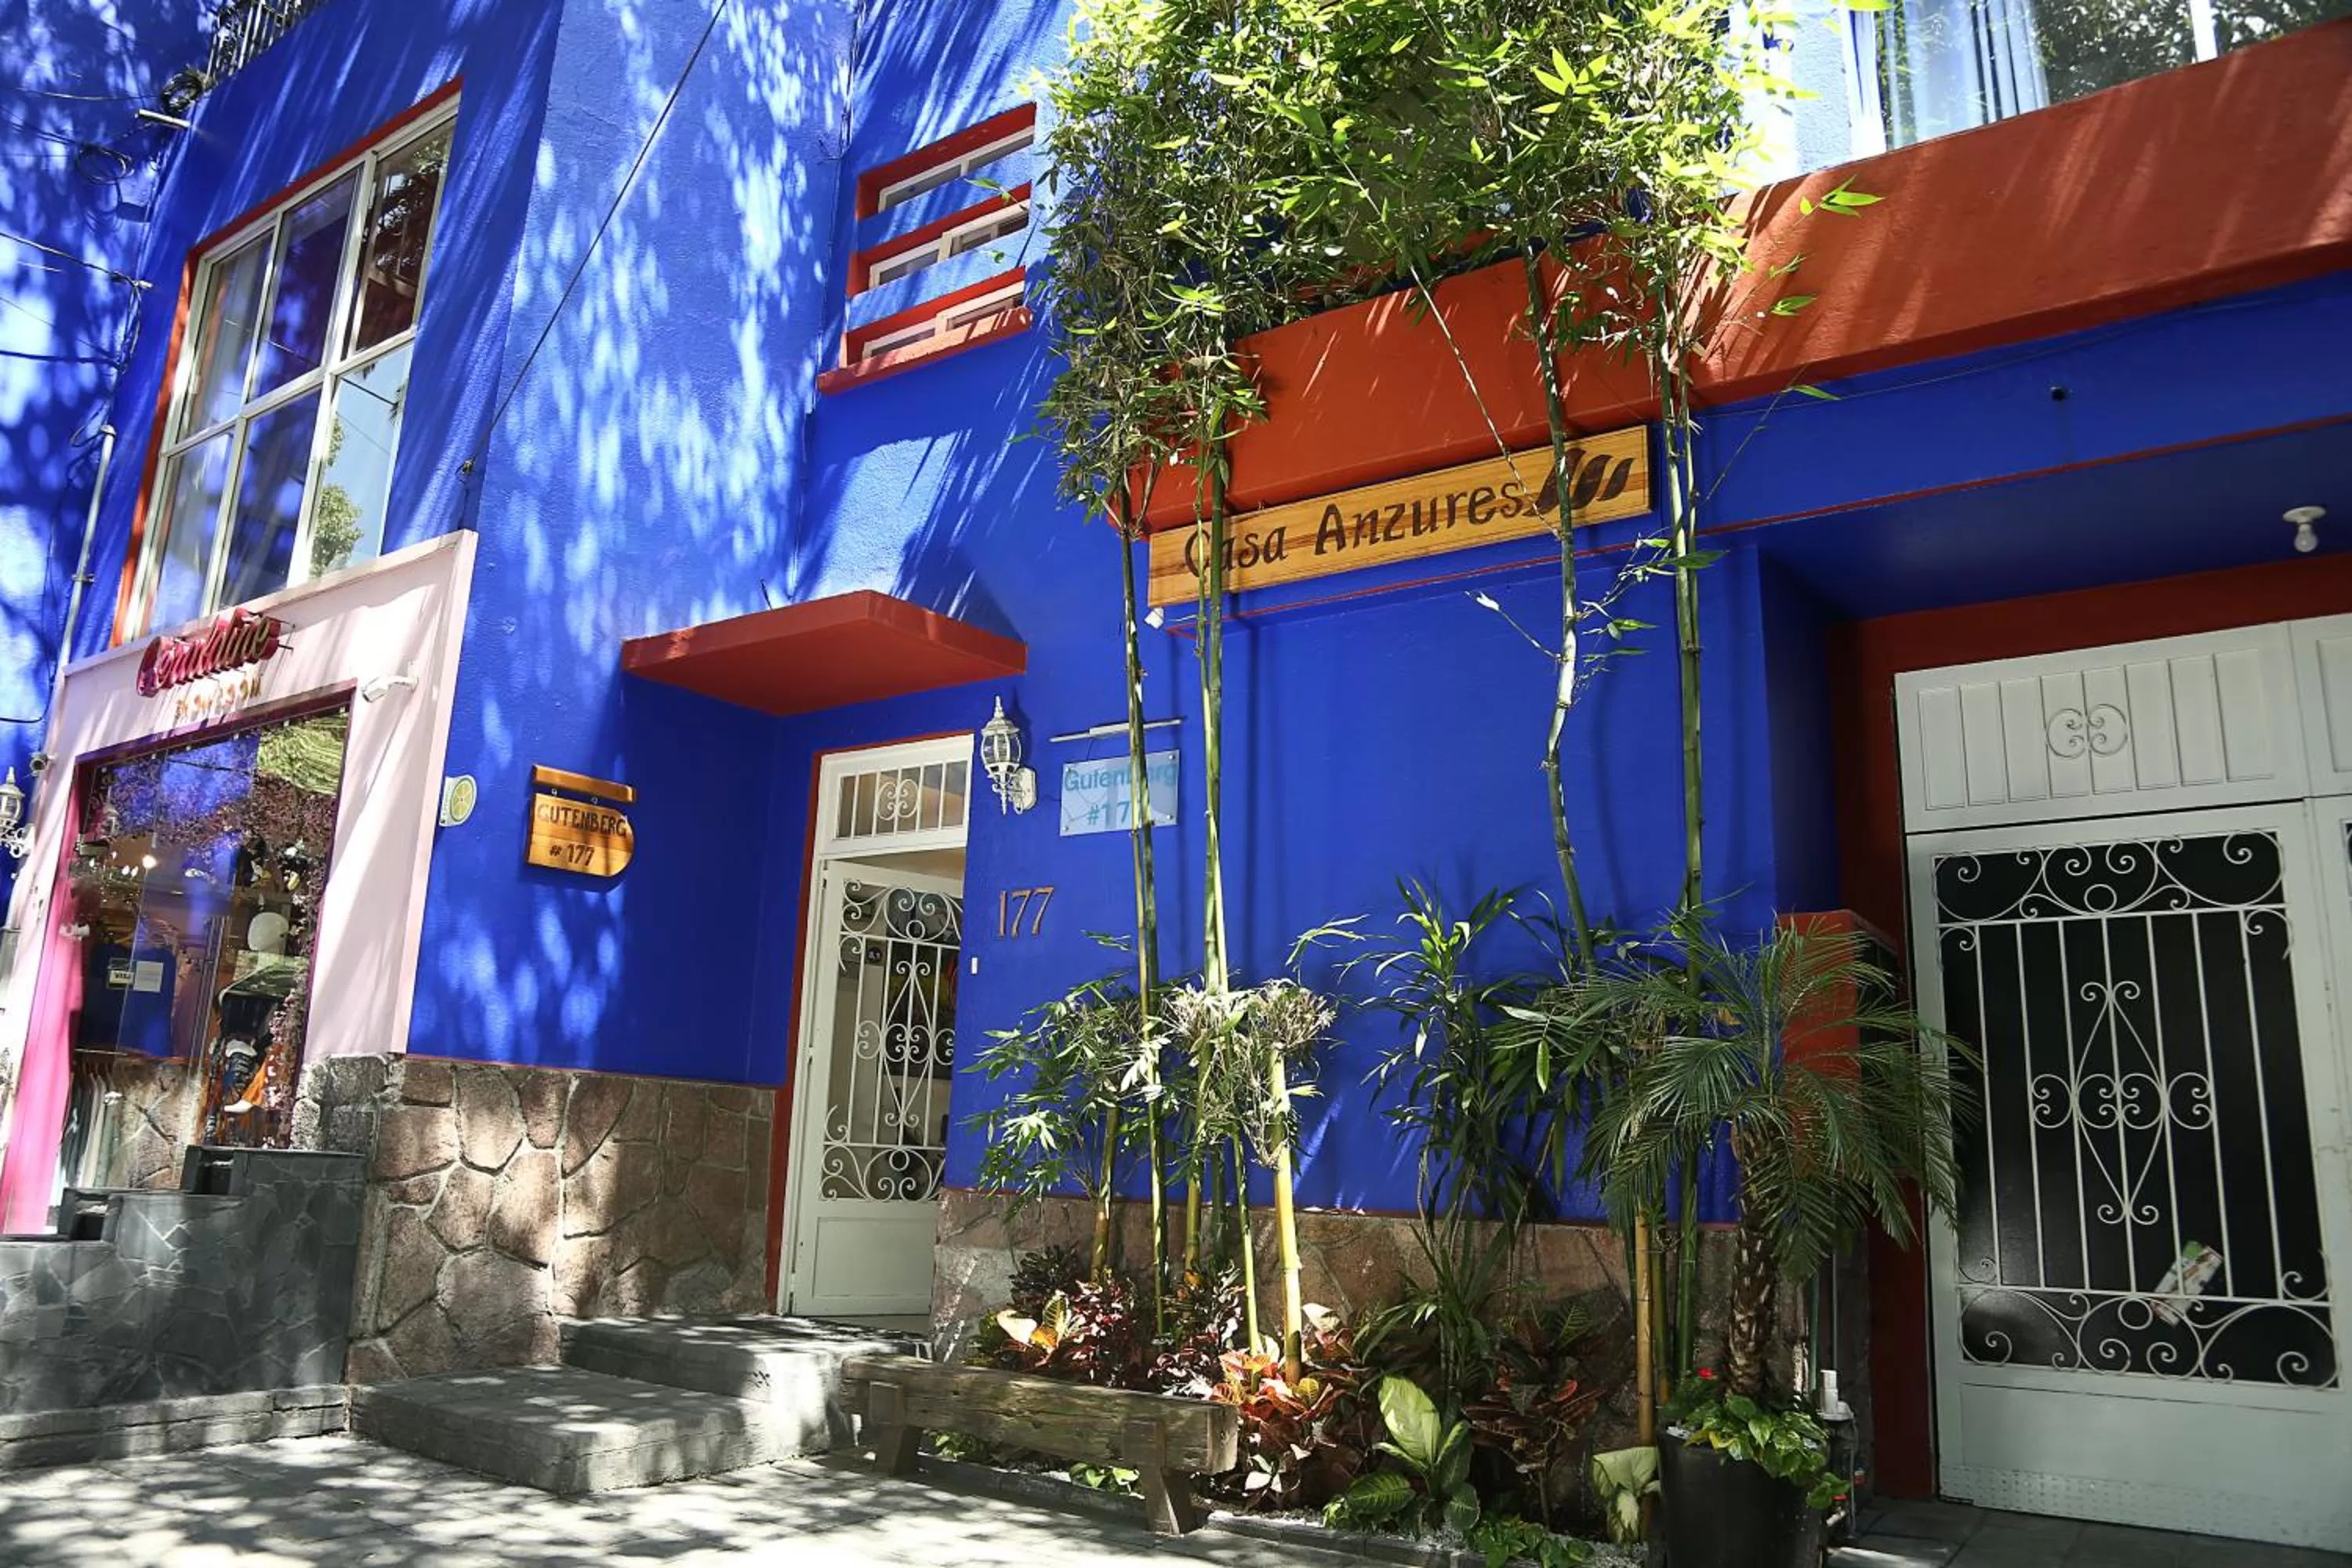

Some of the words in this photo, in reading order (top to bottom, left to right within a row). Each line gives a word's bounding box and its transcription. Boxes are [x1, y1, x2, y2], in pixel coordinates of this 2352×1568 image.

[1185, 527, 1288, 578] Casa
[1315, 482, 1524, 555] Anzures
[538, 804, 626, 837] GUTENBERG
[568, 843, 595, 866] 177
[997, 886, 1054, 938] 177
